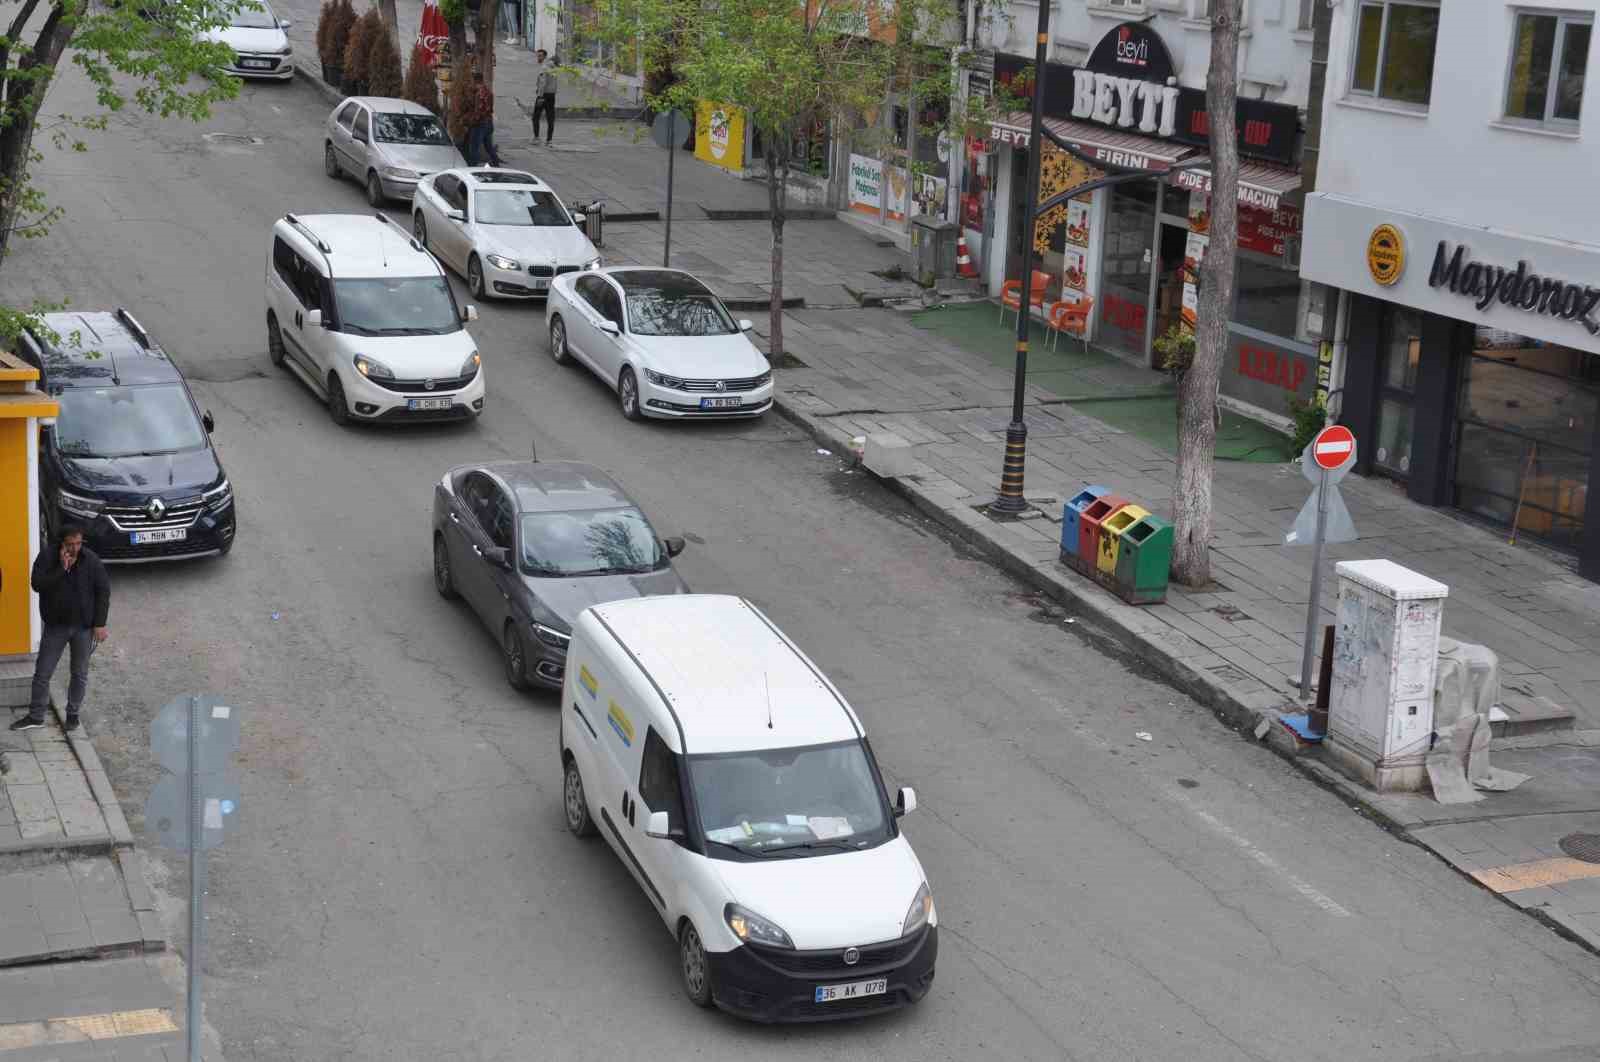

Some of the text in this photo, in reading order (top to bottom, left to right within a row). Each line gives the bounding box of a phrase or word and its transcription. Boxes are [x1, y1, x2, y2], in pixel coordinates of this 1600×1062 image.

[991, 126, 1033, 147] BEYT
[1237, 186, 1279, 209] MACUN
[1428, 240, 1600, 335] Maydonoz
[845, 984, 857, 997] AK
